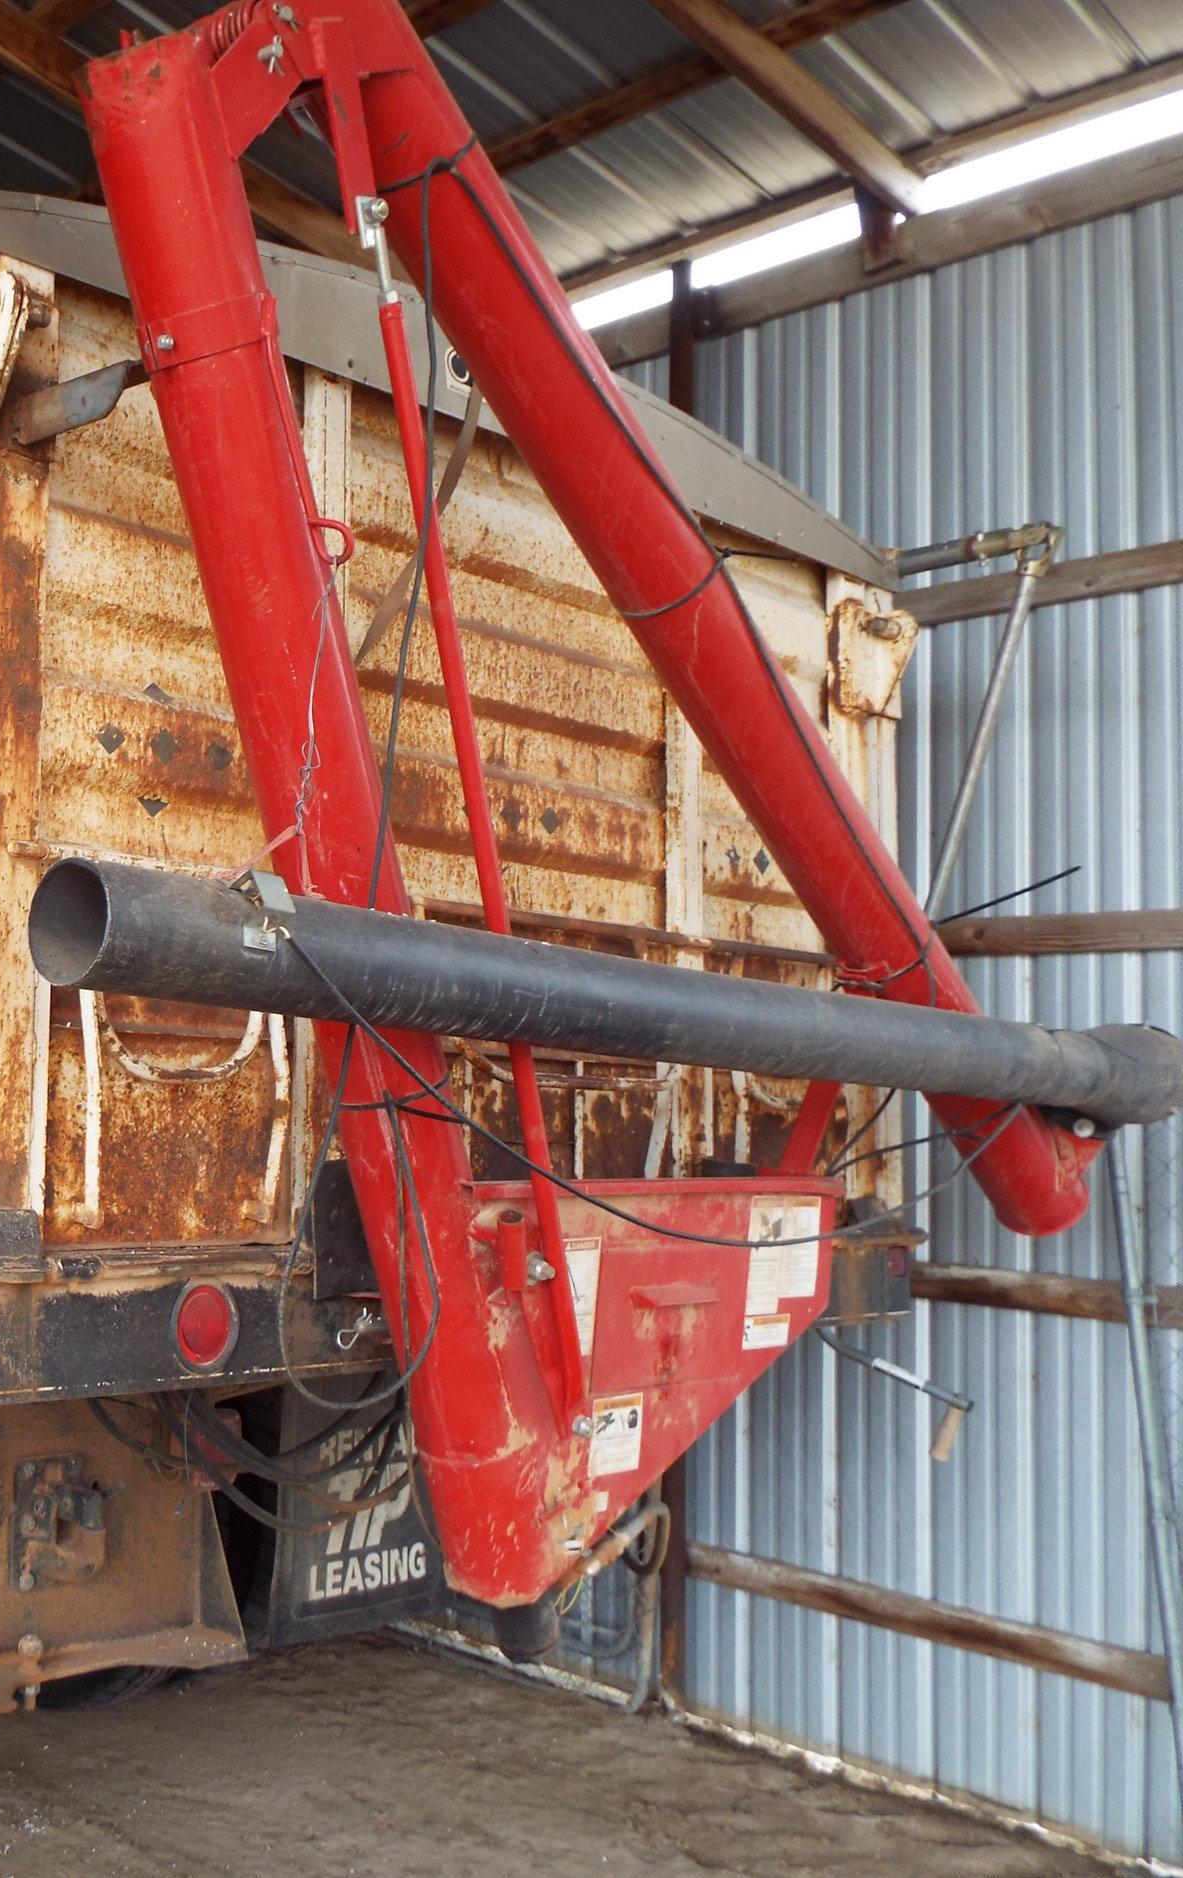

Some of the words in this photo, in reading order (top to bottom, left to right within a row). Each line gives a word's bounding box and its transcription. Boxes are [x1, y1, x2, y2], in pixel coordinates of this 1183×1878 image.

[319, 1422, 416, 1467] RENTA
[326, 1462, 411, 1555] TIP
[309, 1542, 426, 1600] LEASING
